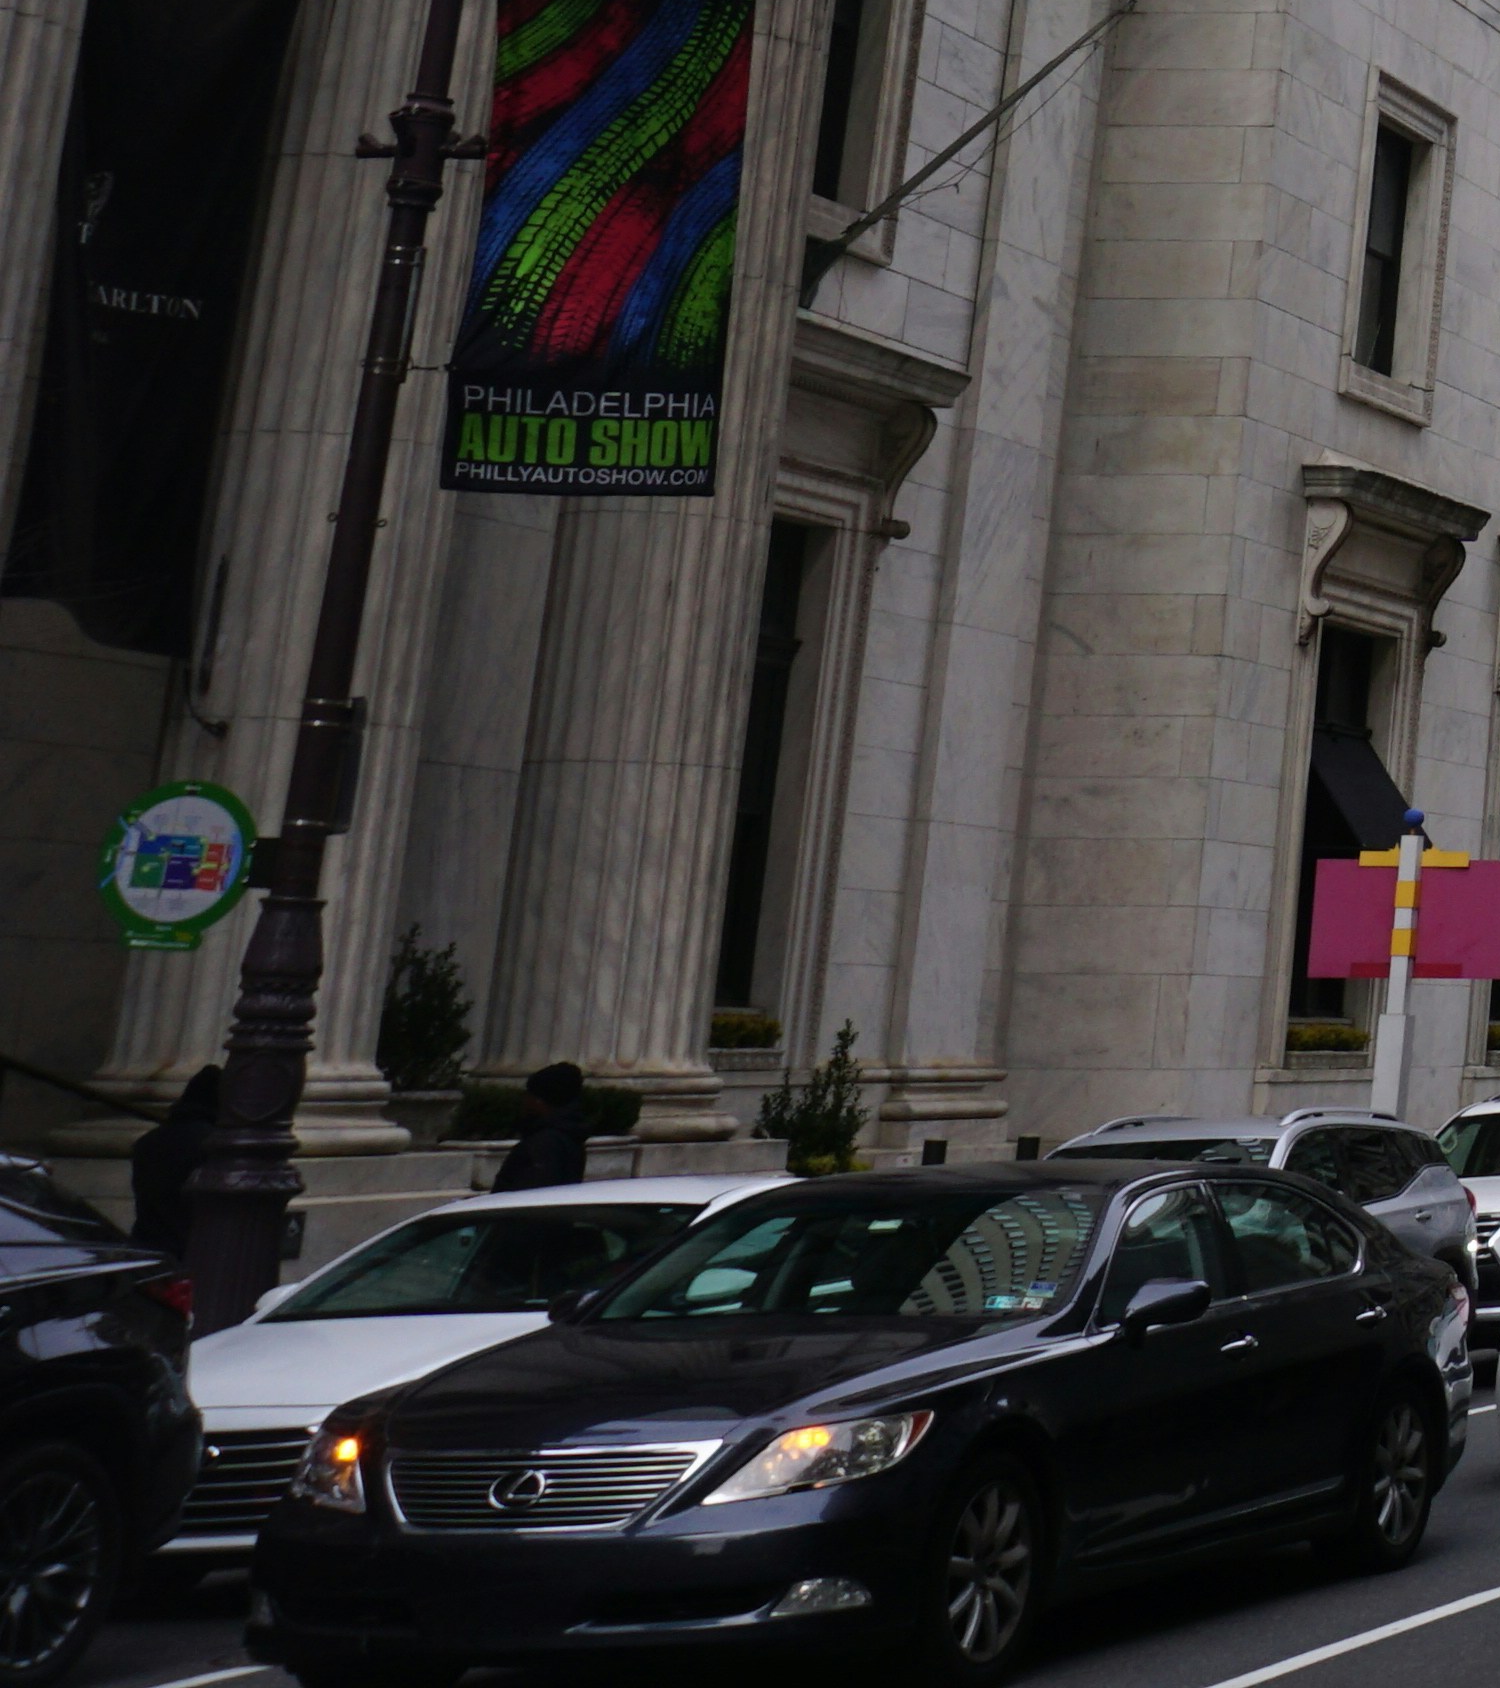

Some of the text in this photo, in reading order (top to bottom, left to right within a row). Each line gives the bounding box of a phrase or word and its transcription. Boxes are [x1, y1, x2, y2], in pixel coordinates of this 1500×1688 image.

[463, 385, 715, 418] PHILADELPHIA
[456, 412, 714, 467] AUTO SHOW
